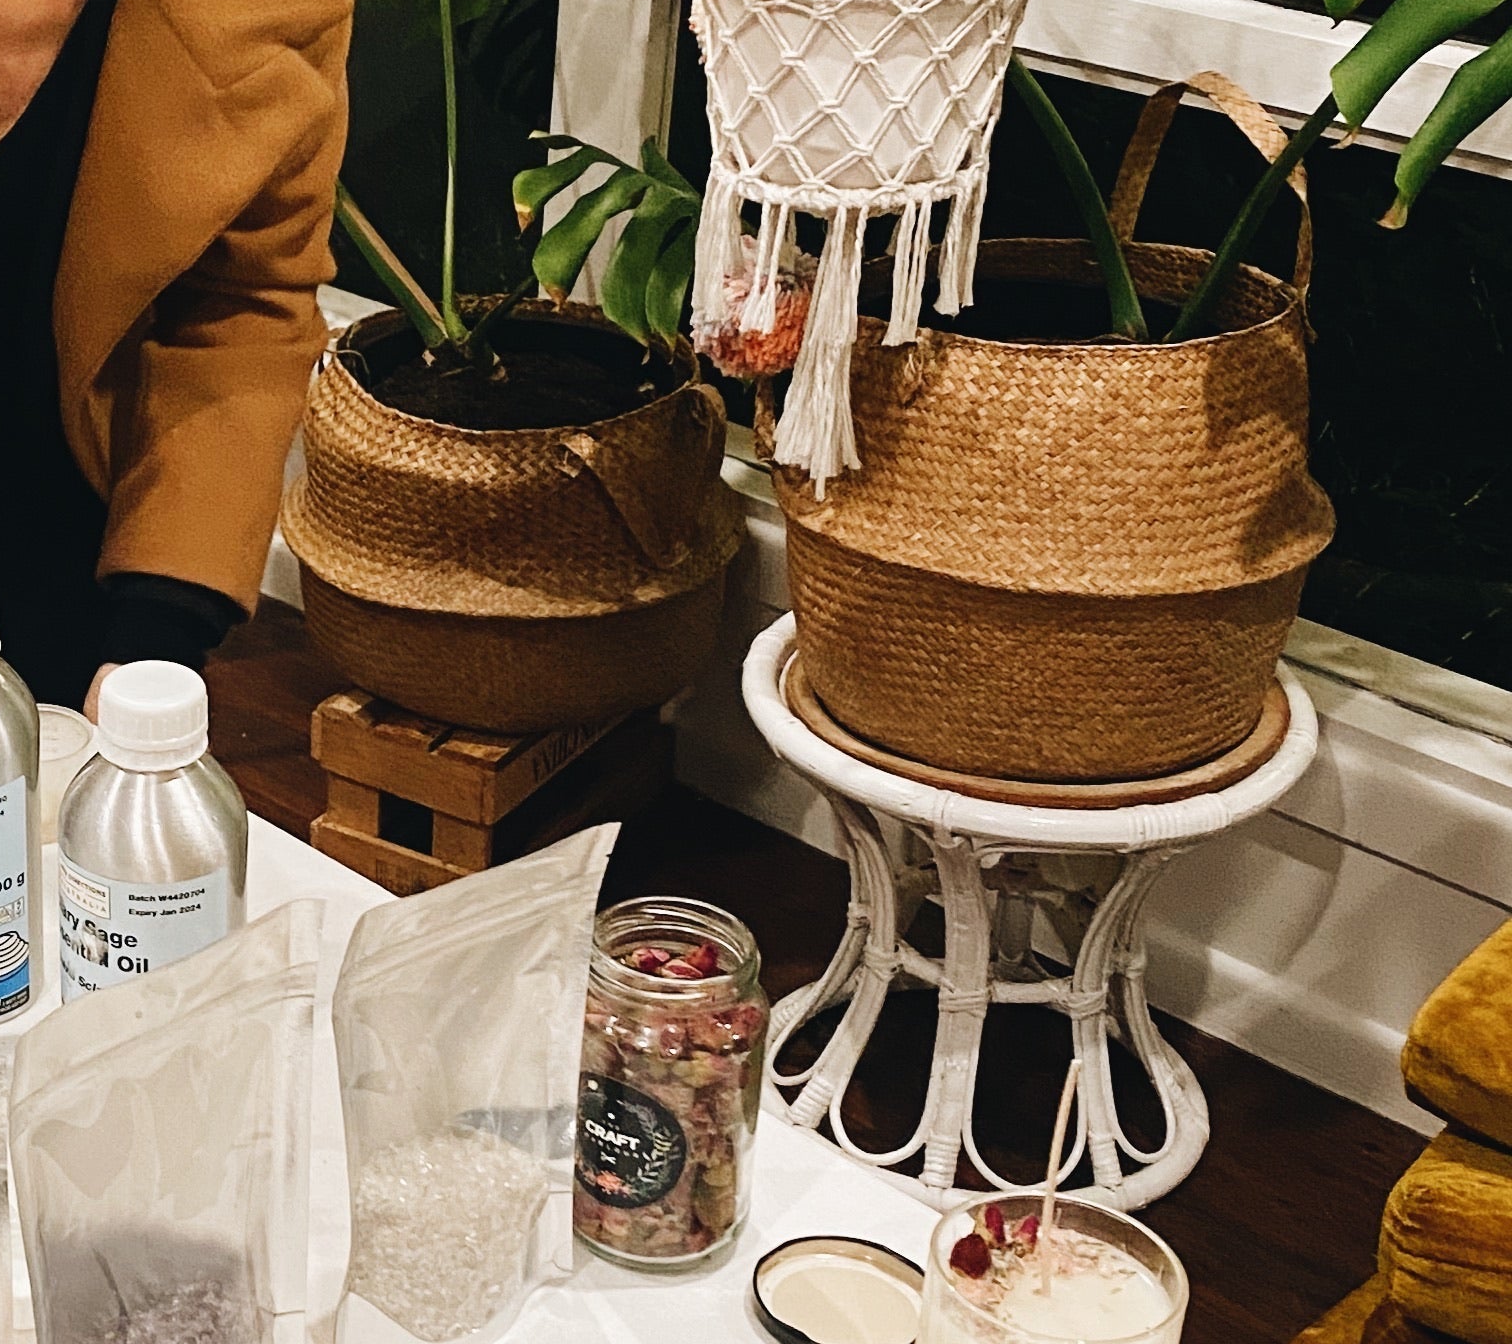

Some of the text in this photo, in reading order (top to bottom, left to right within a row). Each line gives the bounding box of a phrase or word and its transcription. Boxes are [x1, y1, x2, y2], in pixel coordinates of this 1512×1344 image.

[16, 872, 26, 888] g
[128, 894, 156, 902] Batch
[128, 908, 158, 917] Expiry
[178, 903, 202, 914] 2024
[82, 919, 138, 949] Sage
[117, 955, 149, 974] Oil
[585, 1119, 640, 1151] CRAFT
